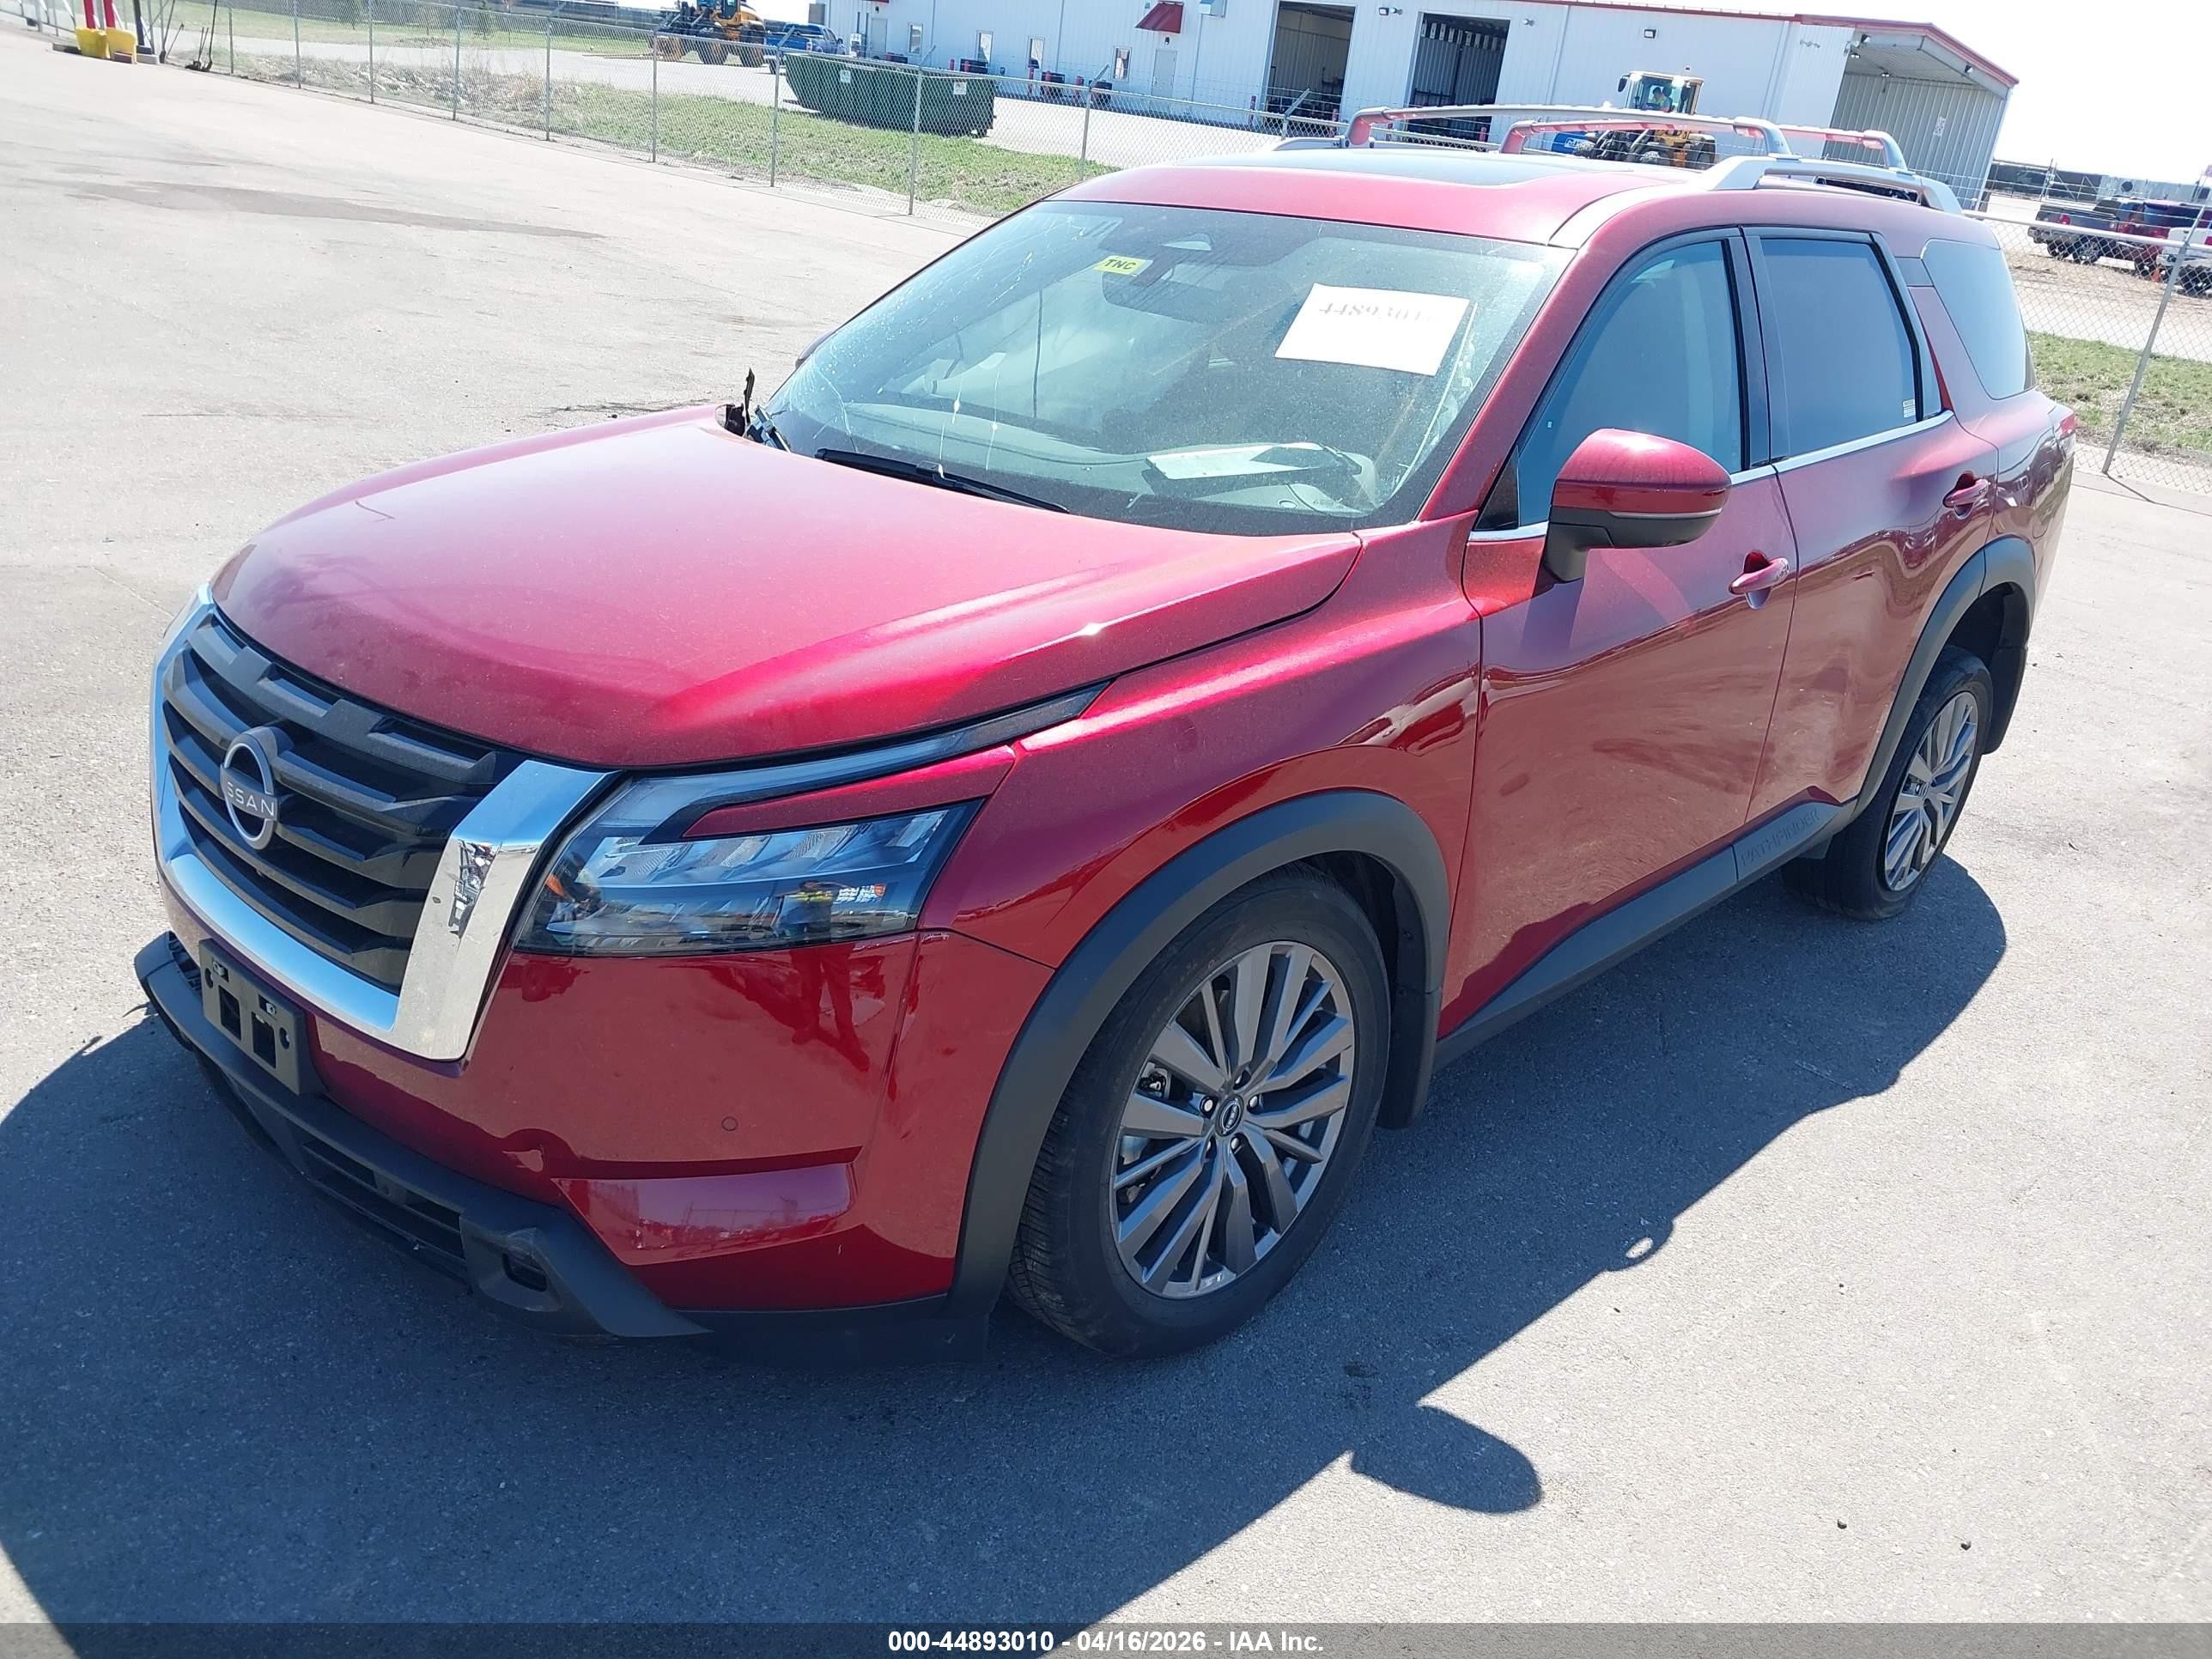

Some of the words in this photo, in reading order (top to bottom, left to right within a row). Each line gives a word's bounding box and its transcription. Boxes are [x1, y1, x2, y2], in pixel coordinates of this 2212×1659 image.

[1104, 258, 1137, 270] TNC
[1319, 301, 1430, 321] 4489301
[227, 781, 275, 816] SSAN
[1740, 808, 1820, 866] PATHFINDER
